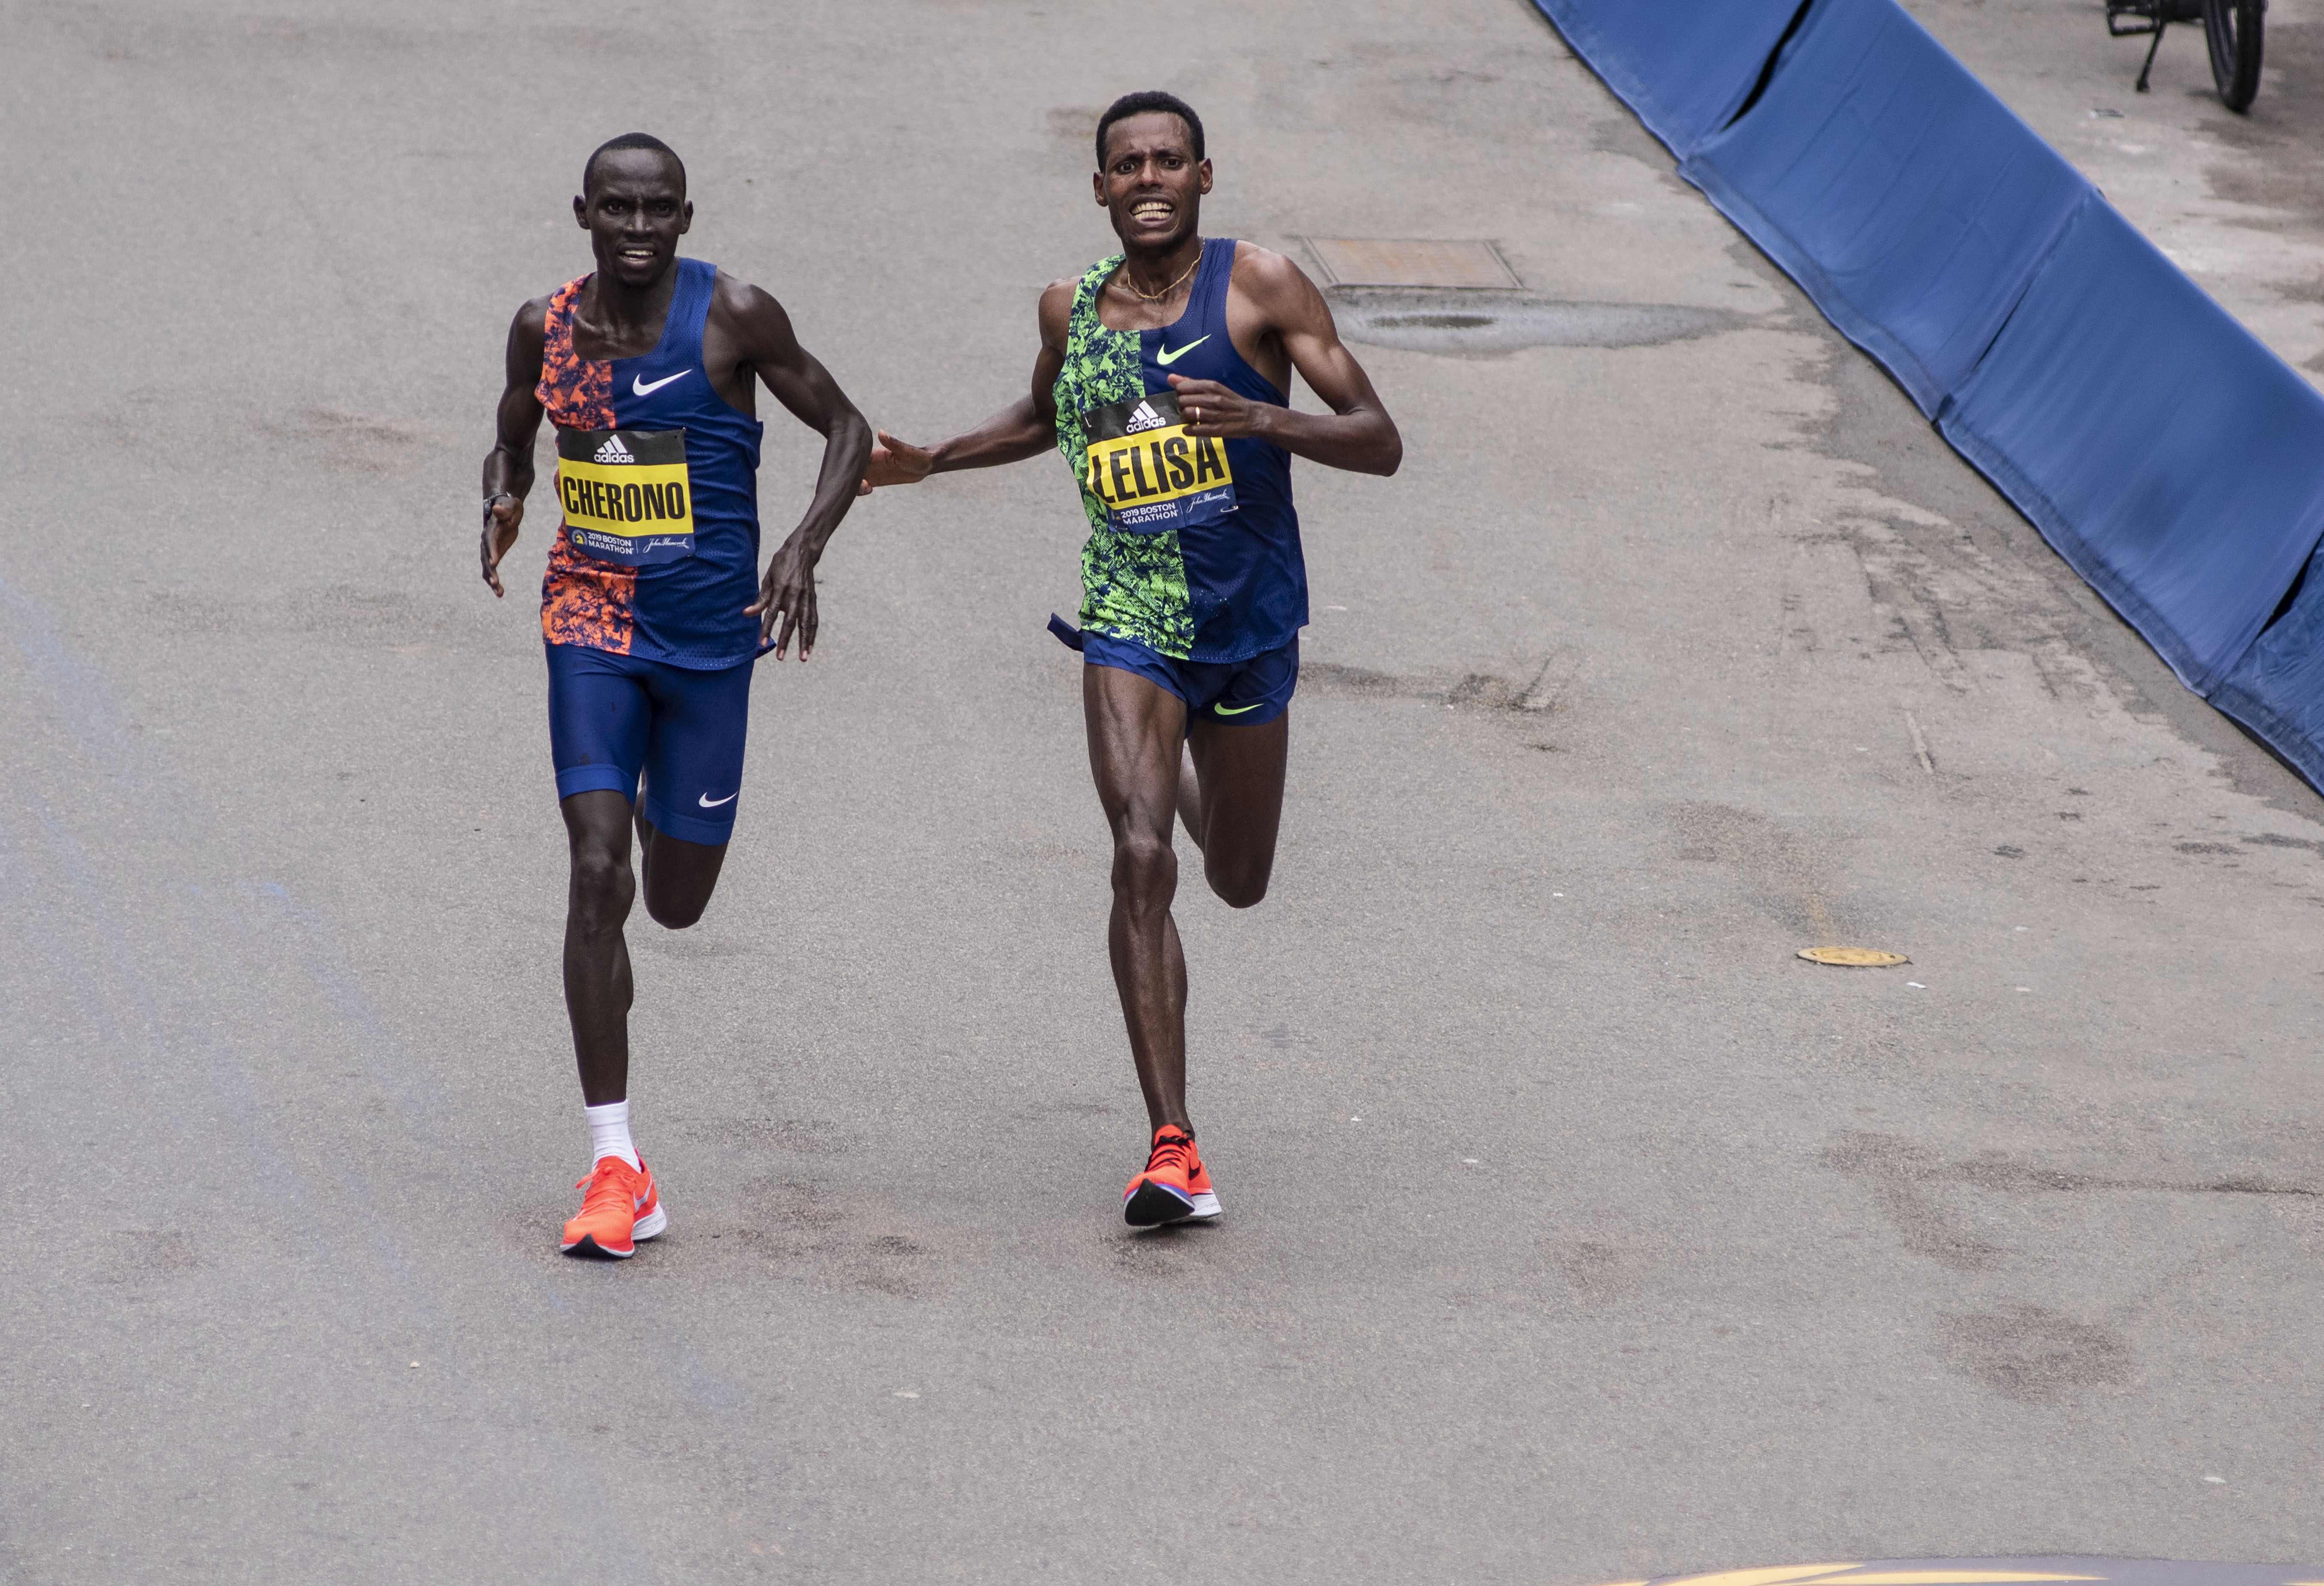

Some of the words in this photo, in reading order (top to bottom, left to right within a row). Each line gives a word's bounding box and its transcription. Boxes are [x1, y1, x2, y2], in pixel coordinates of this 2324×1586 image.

[1126, 417, 1166, 433] adidas
[594, 452, 634, 463] adidas
[1092, 436, 1225, 504] LELISA
[563, 476, 685, 522] CHERONO
[1121, 508, 1139, 519] 2019
[1140, 502, 1175, 515] BOSTON
[1123, 509, 1178, 525] MARATHON
[588, 532, 602, 541] 2019
[602, 535, 632, 547] BOSTON
[589, 540, 634, 555] MARATHON
